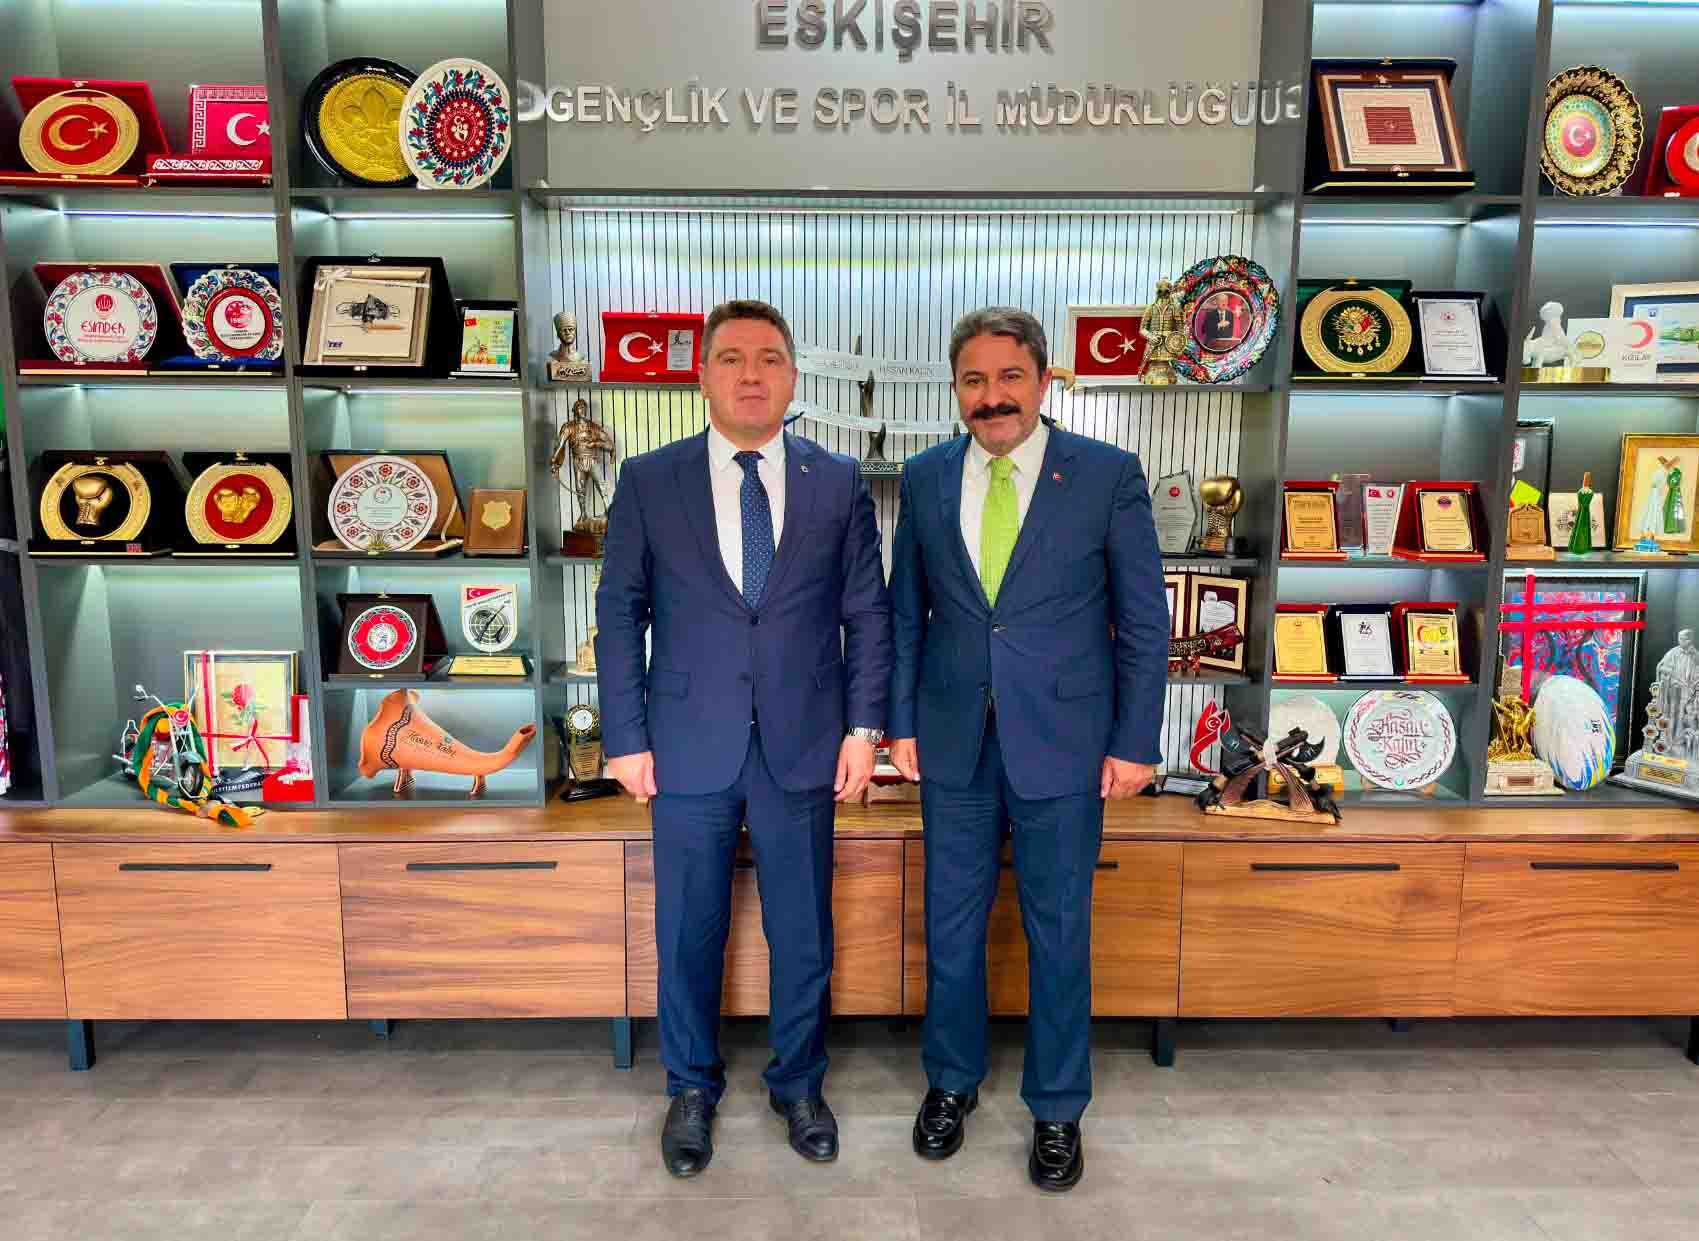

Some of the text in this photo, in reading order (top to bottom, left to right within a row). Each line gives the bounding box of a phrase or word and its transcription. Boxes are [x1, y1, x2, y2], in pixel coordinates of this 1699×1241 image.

[546, 78, 1257, 132] GENÇLİK VE SPOR İL MÜDÜRLÜĞÜ
